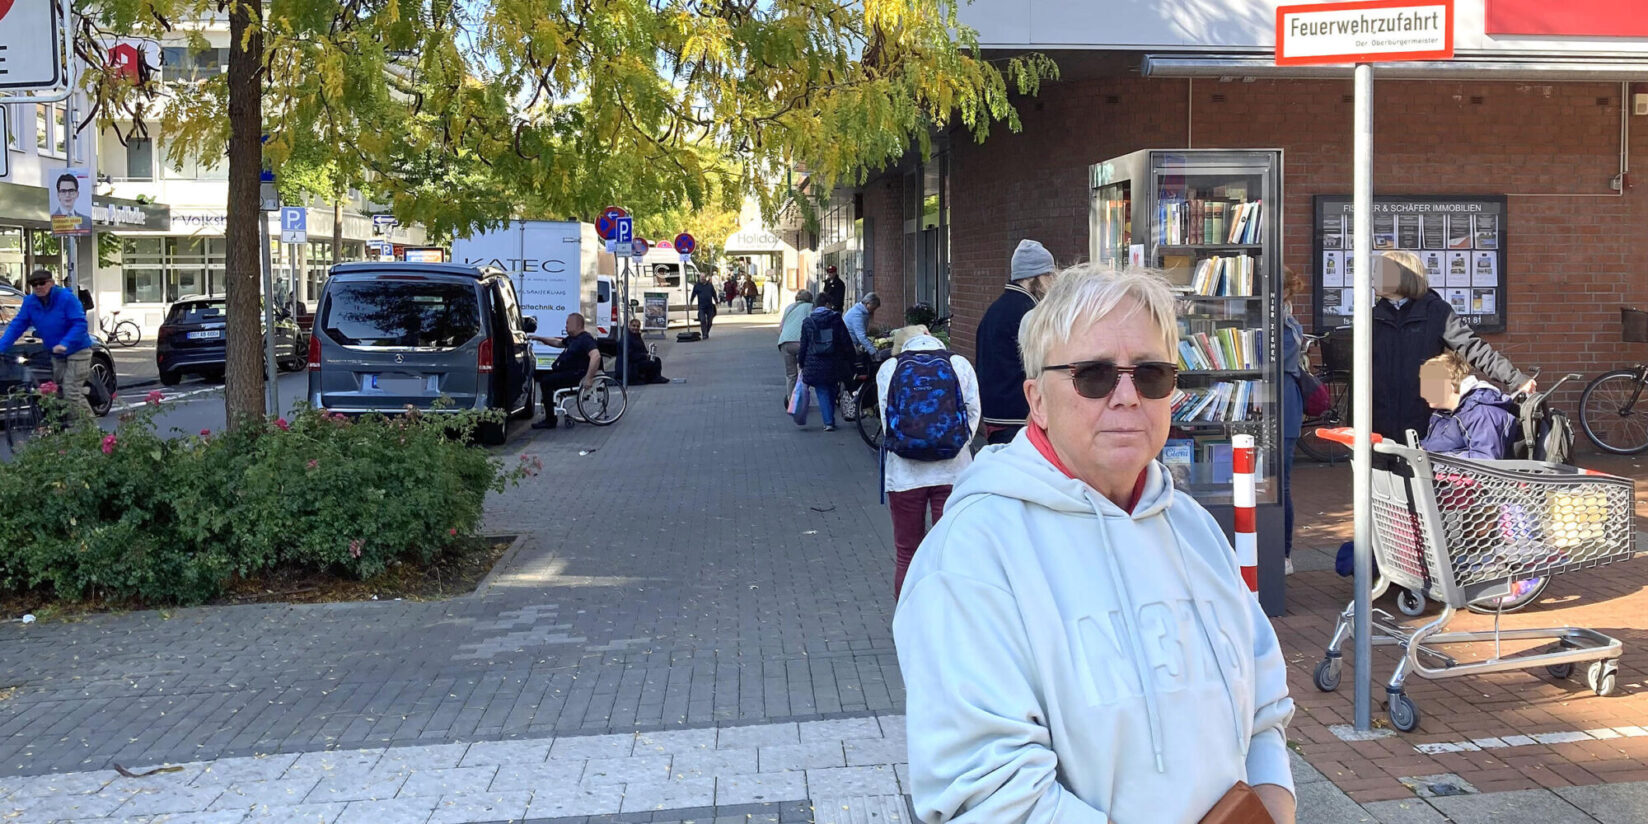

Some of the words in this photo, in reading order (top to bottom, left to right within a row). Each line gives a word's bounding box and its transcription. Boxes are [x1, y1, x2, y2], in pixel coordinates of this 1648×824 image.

[1291, 12, 1438, 36] Feuerwehrzufahrt
[1390, 202, 1431, 212] SCHÄFER
[286, 210, 300, 229] P
[620, 221, 629, 242] P
